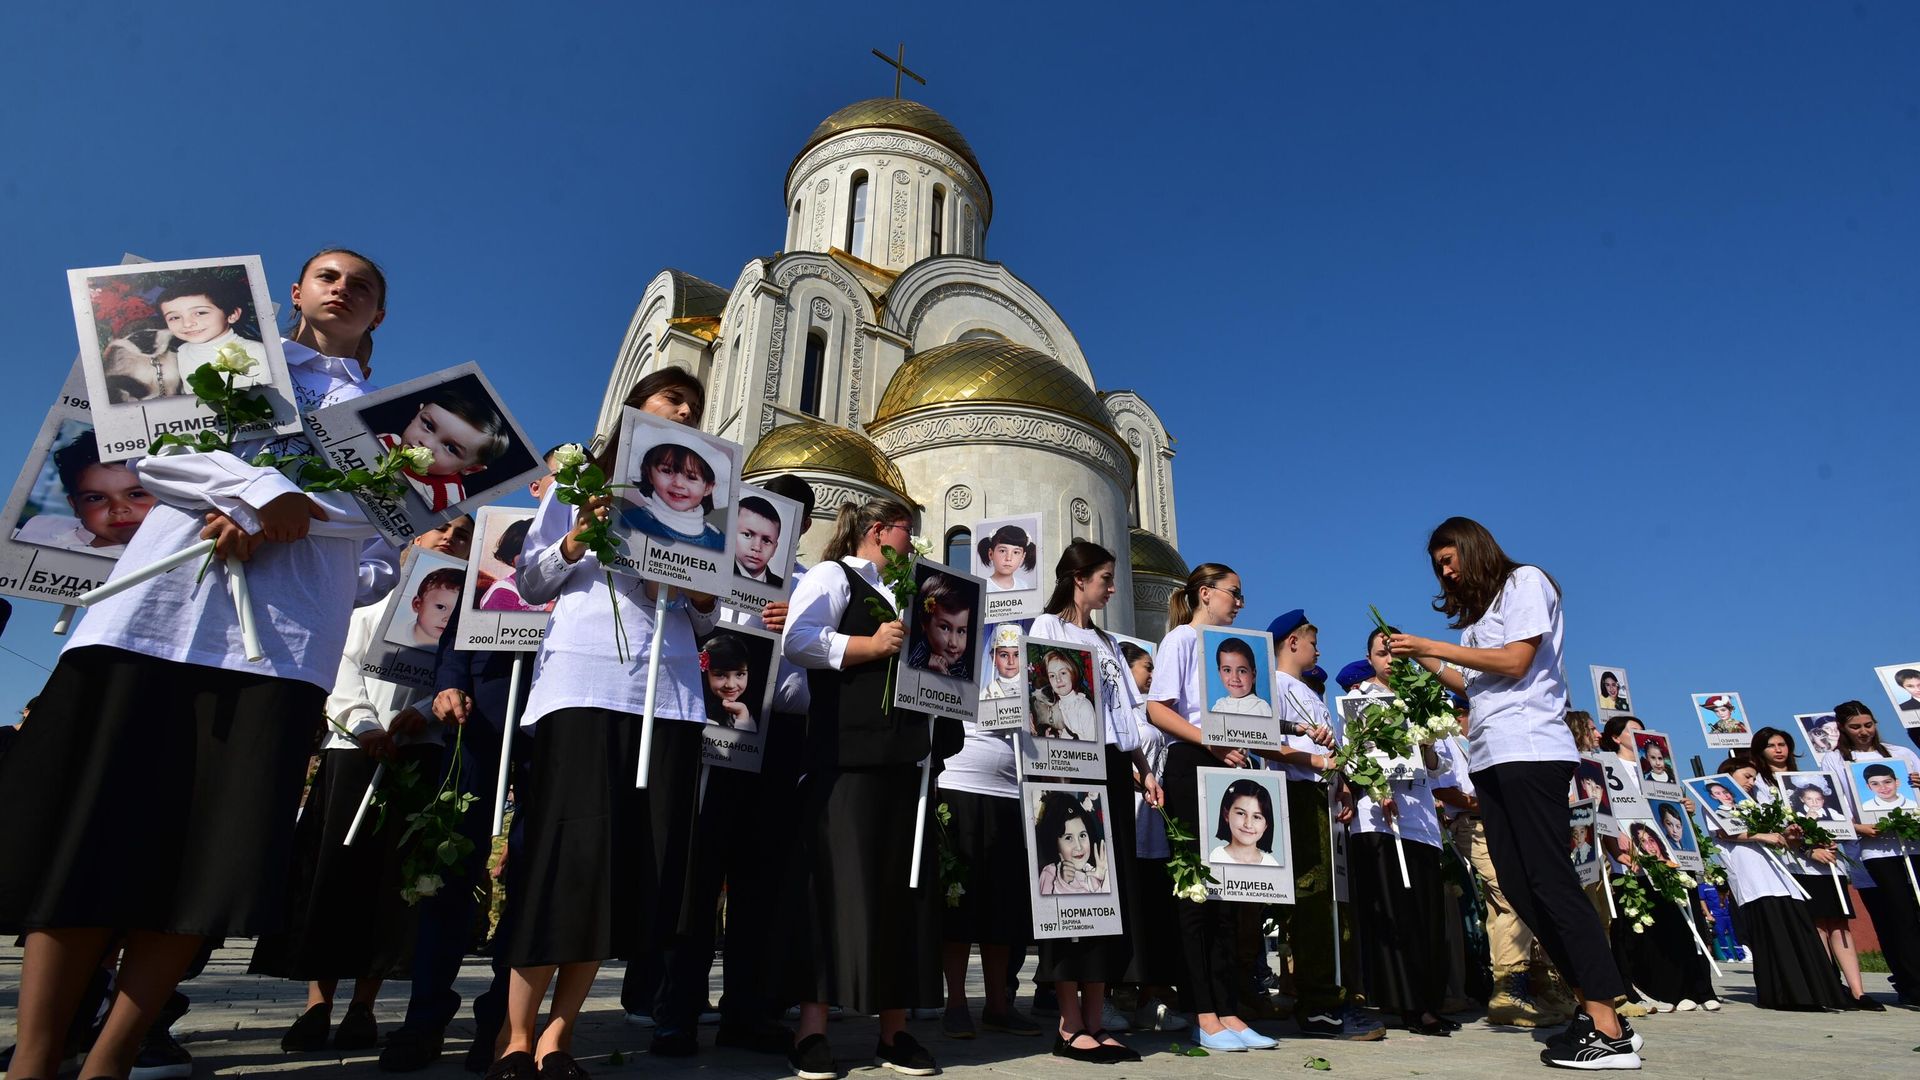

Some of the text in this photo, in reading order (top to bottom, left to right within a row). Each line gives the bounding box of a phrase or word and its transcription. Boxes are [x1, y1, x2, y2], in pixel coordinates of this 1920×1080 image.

[63, 395, 92, 412] 199
[305, 415, 331, 443] 2001
[104, 438, 147, 454] 1998
[329, 451, 350, 476] АЛЬБЕ
[338, 448, 415, 539] АДХАЕВ
[615, 555, 640, 570] 2001
[650, 547, 717, 573] МАЛИЕВА
[648, 559, 687, 575] СВЕТЛАНА
[647, 567, 692, 582] АСЛАНОВНА
[731, 589, 774, 607] РЧИНО
[989, 598, 1023, 609] ДЗИОВА
[468, 636, 494, 644] 2000
[363, 663, 388, 676] 2002
[898, 693, 915, 705] 2001
[920, 687, 962, 706] ГОЛОЕВА
[919, 700, 944, 711] КРИСТИНА
[999, 706, 1021, 715] КУНД
[1208, 733, 1224, 742] 1997
[1226, 729, 1268, 740] КУЧИЕВА
[702, 750, 732, 762] ЕРЬЕВНА
[1050, 749, 1099, 761] ХУЗМИЕВА
[1031, 761, 1048, 770] 1997
[1605, 766, 1624, 791] 3
[1206, 887, 1223, 895] 997
[1226, 880, 1275, 891] ДУДИЕВА
[1245, 891, 1288, 899] АХСАРБЕКОВНА
[1060, 907, 1116, 918] НОРМАТОВА
[1040, 922, 1058, 932] 1997
